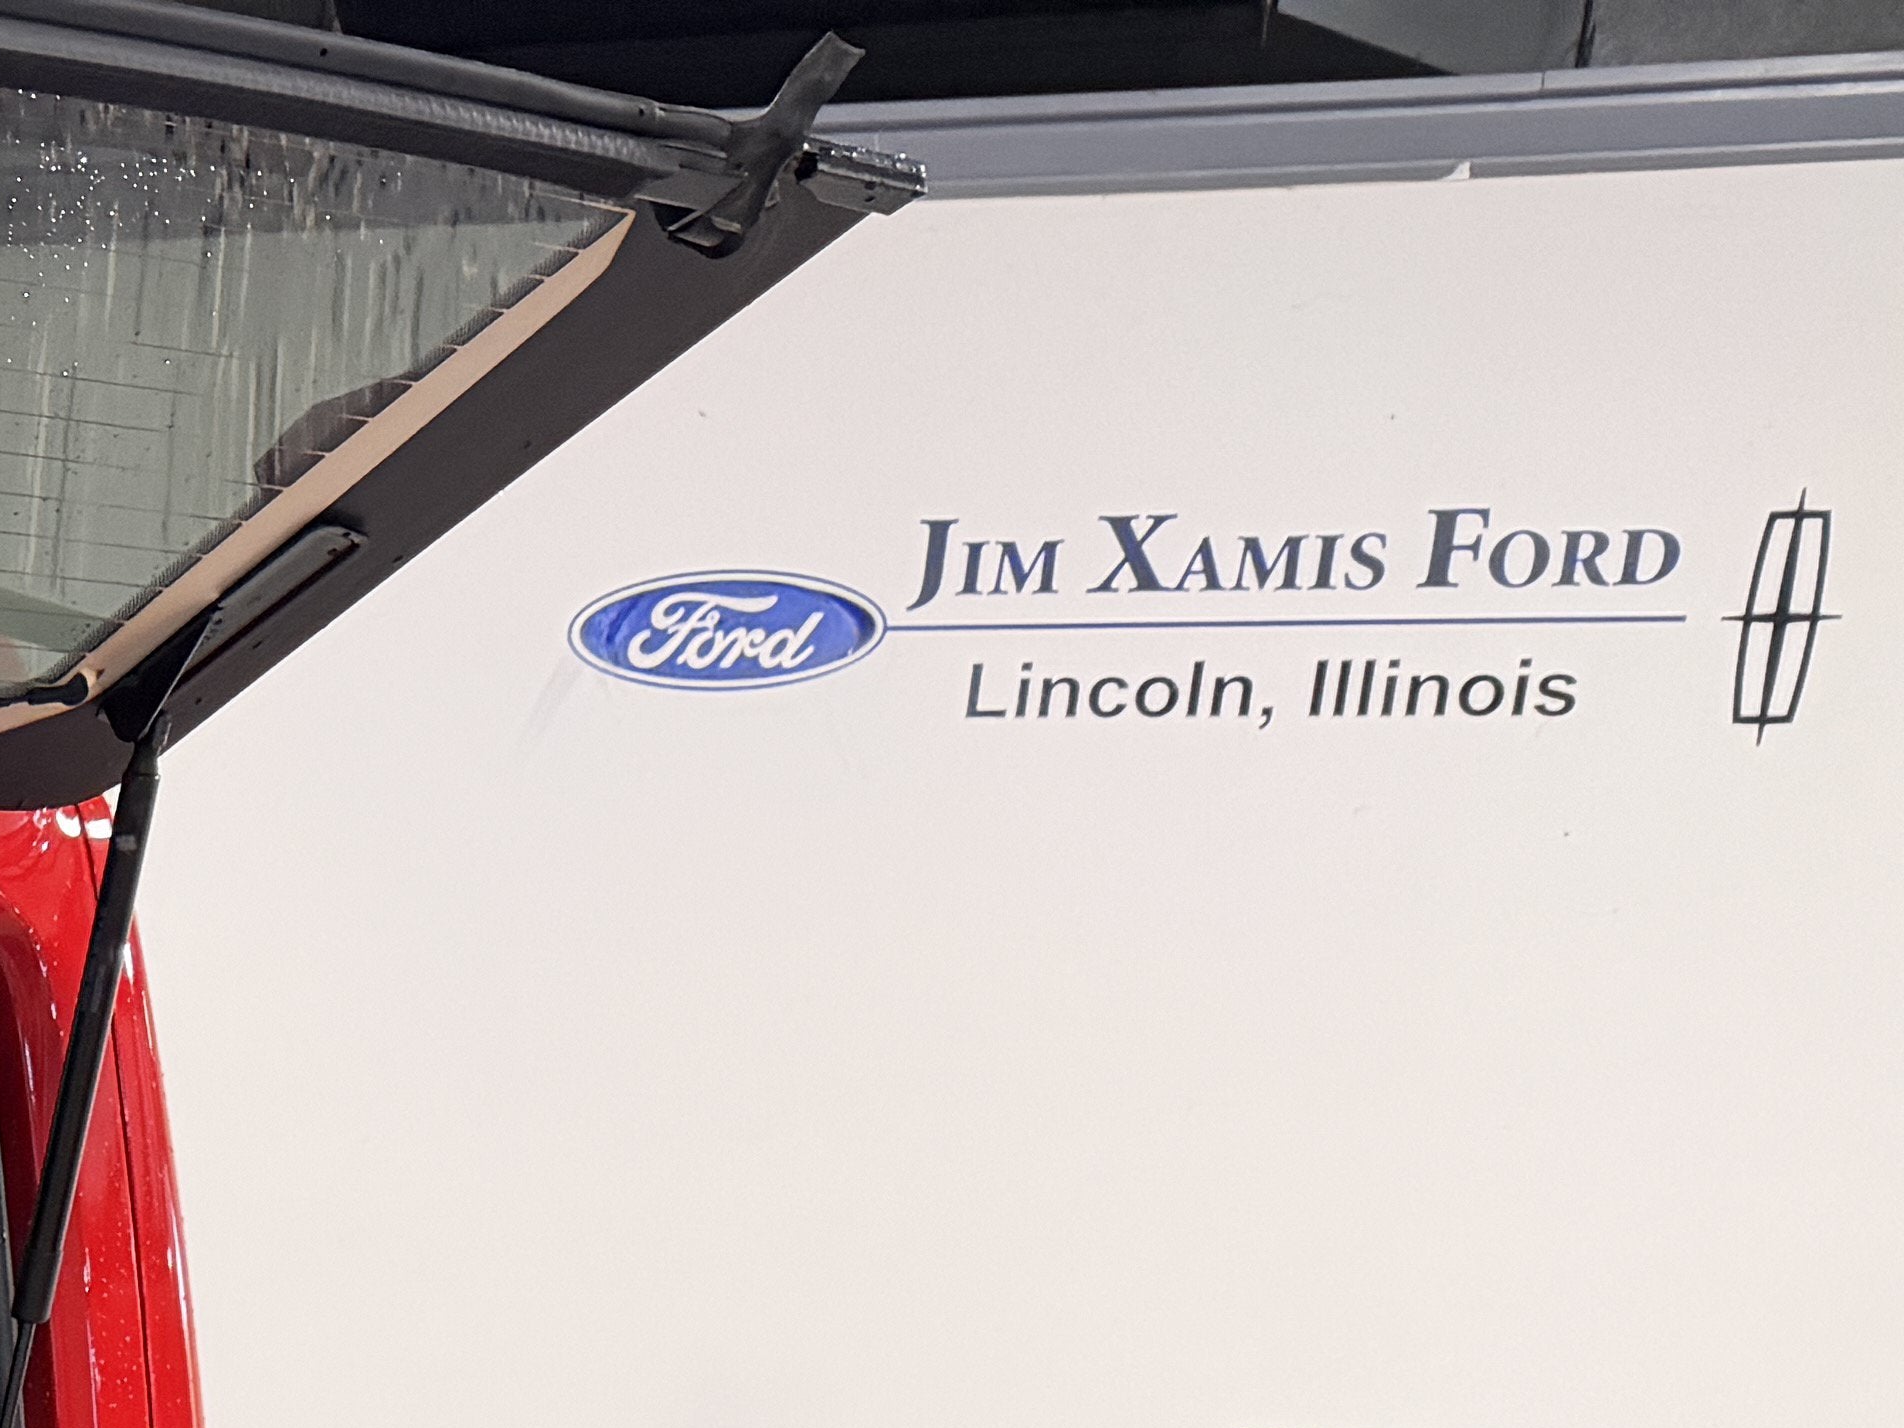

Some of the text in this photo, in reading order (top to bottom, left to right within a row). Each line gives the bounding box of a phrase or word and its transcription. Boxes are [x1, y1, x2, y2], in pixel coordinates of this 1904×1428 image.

[628, 592, 816, 670] Ford
[965, 658, 1577, 730] Lincoln, Illinois
